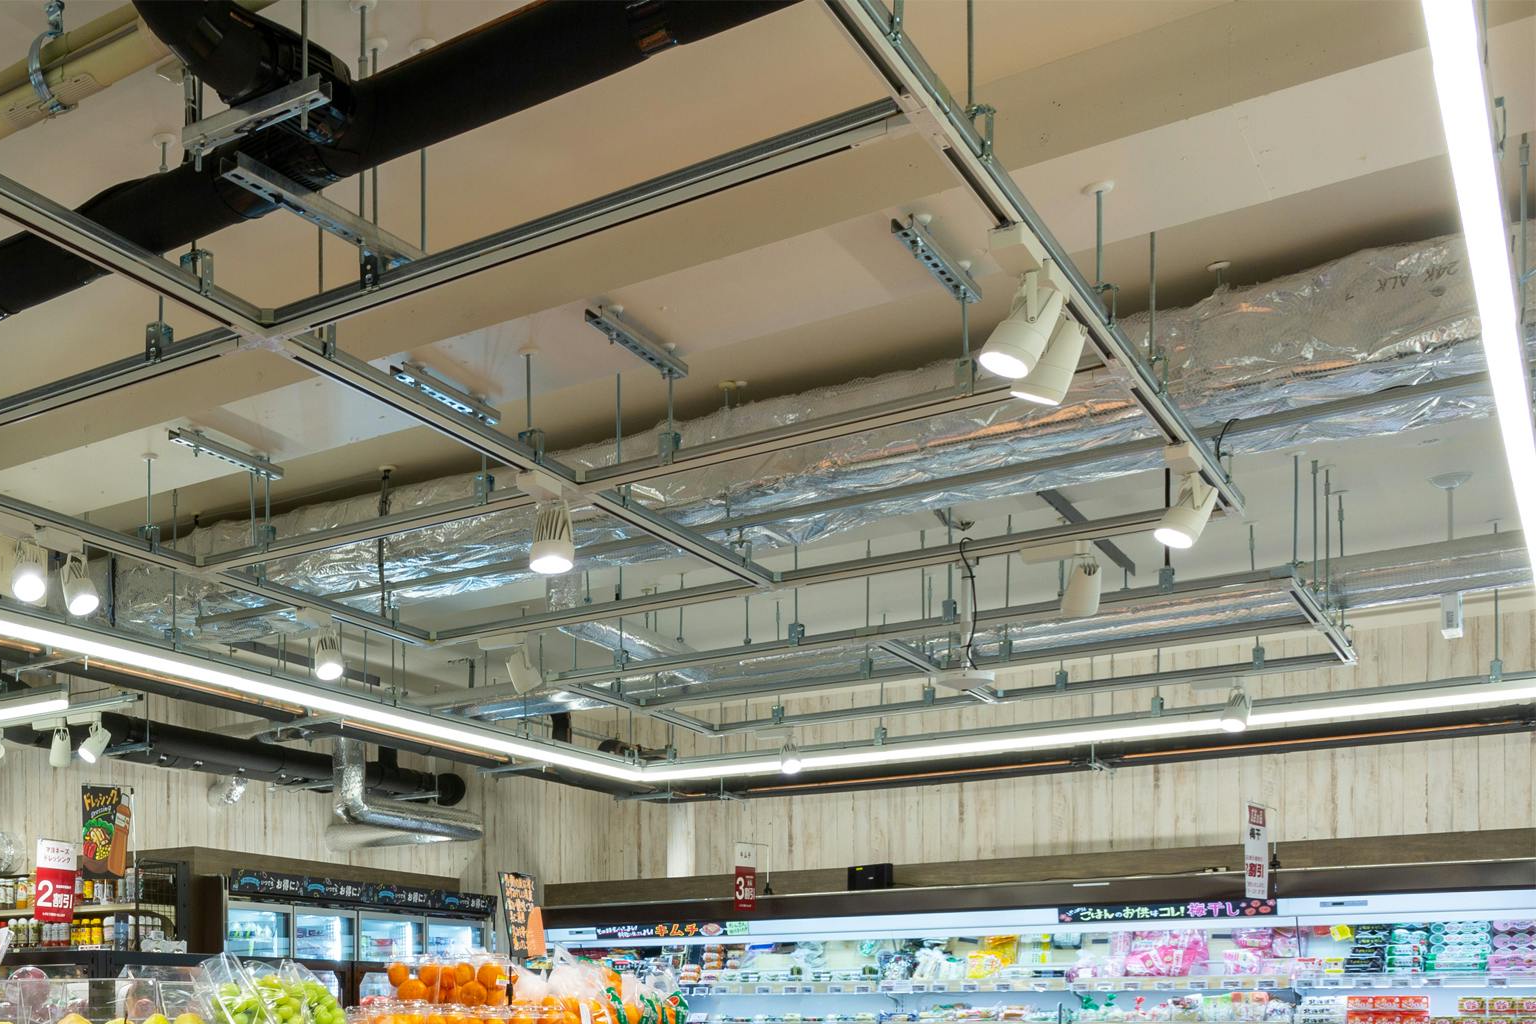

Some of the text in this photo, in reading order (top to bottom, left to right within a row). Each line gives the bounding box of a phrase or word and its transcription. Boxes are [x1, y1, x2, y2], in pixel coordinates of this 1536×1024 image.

[84, 789, 118, 811] ドレッシング
[37, 880, 73, 909] 2割引
[1187, 902, 1240, 918] 梅干し
[655, 923, 698, 937] キムチ
